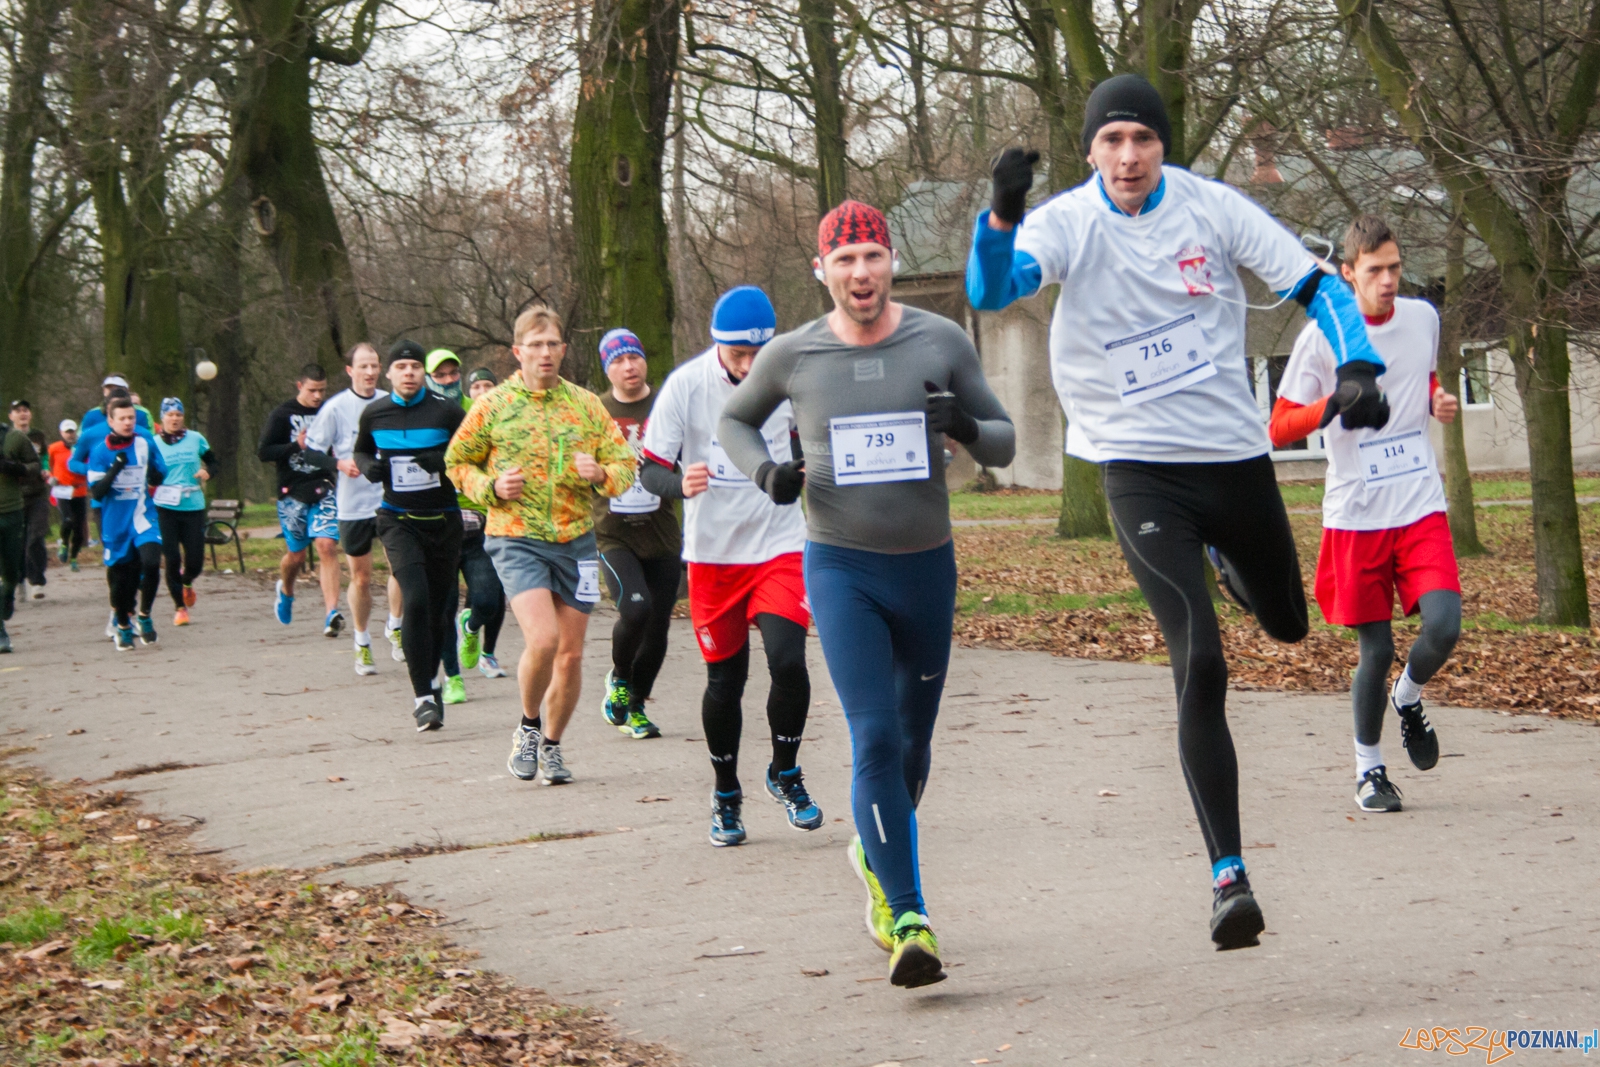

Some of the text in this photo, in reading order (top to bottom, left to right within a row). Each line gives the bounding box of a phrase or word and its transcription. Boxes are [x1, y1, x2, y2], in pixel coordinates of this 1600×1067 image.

[1139, 338, 1173, 361] 716
[864, 432, 895, 448] 739
[1384, 444, 1405, 459] 114
[407, 465, 422, 474] 86
